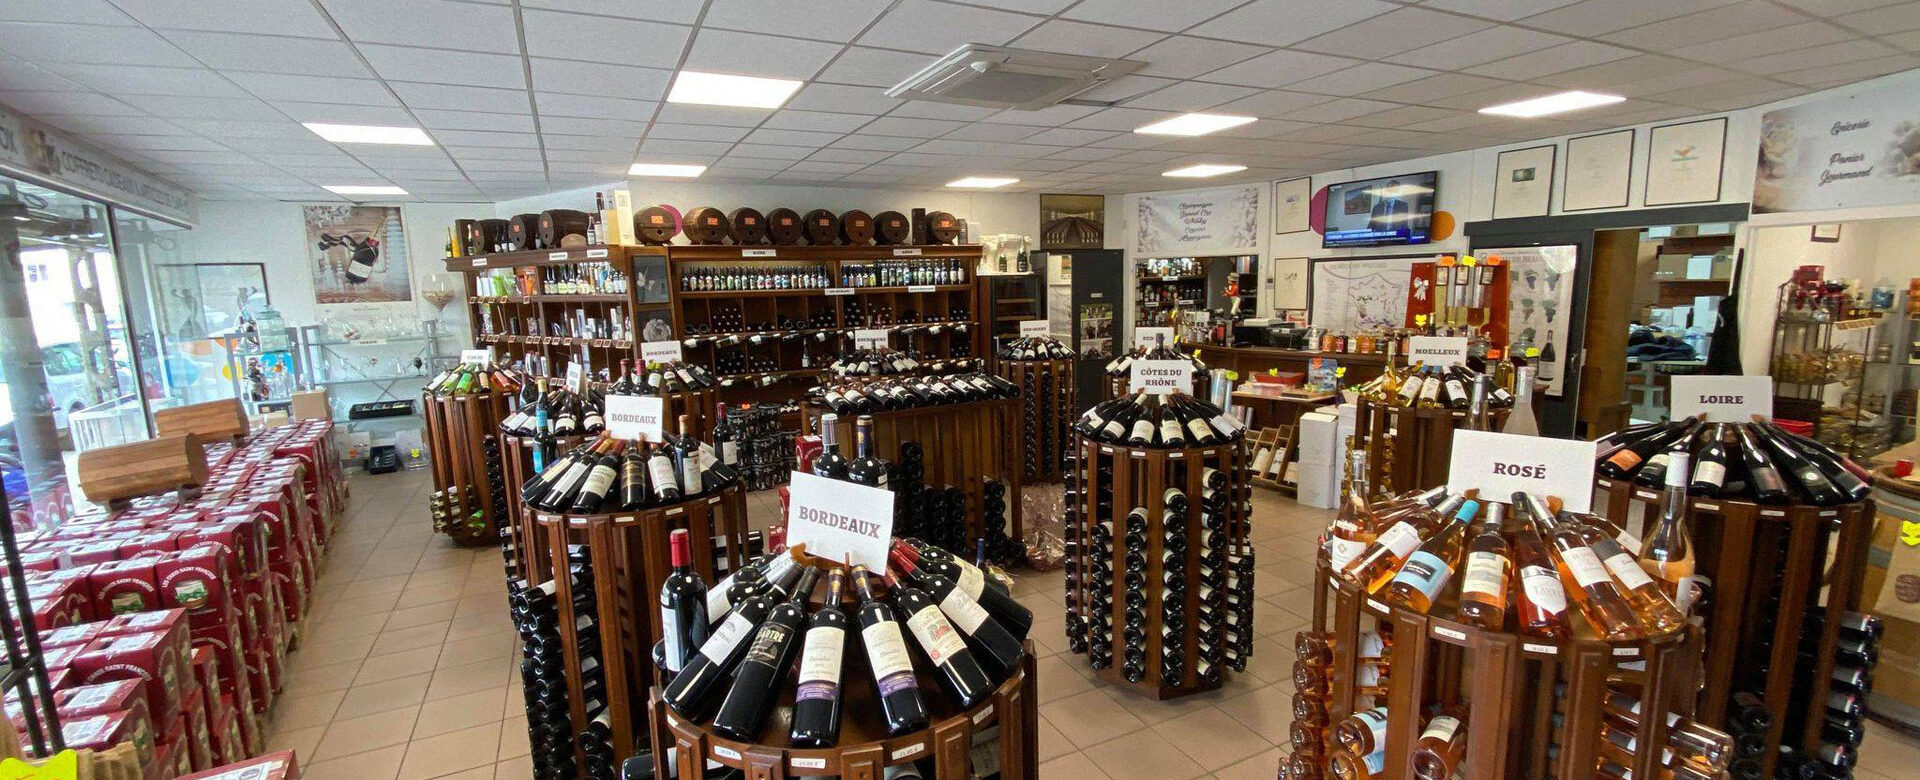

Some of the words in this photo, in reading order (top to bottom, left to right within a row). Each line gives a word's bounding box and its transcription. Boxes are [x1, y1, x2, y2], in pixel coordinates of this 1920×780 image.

[1140, 367, 1168, 376] CÔTES
[1145, 378, 1177, 386] RHÔNE
[1699, 395, 1744, 404] LOIRE
[611, 413, 657, 425] BORDEAUX
[1493, 462, 1546, 479] ROSÉ
[798, 505, 881, 539] BORDEAUX
